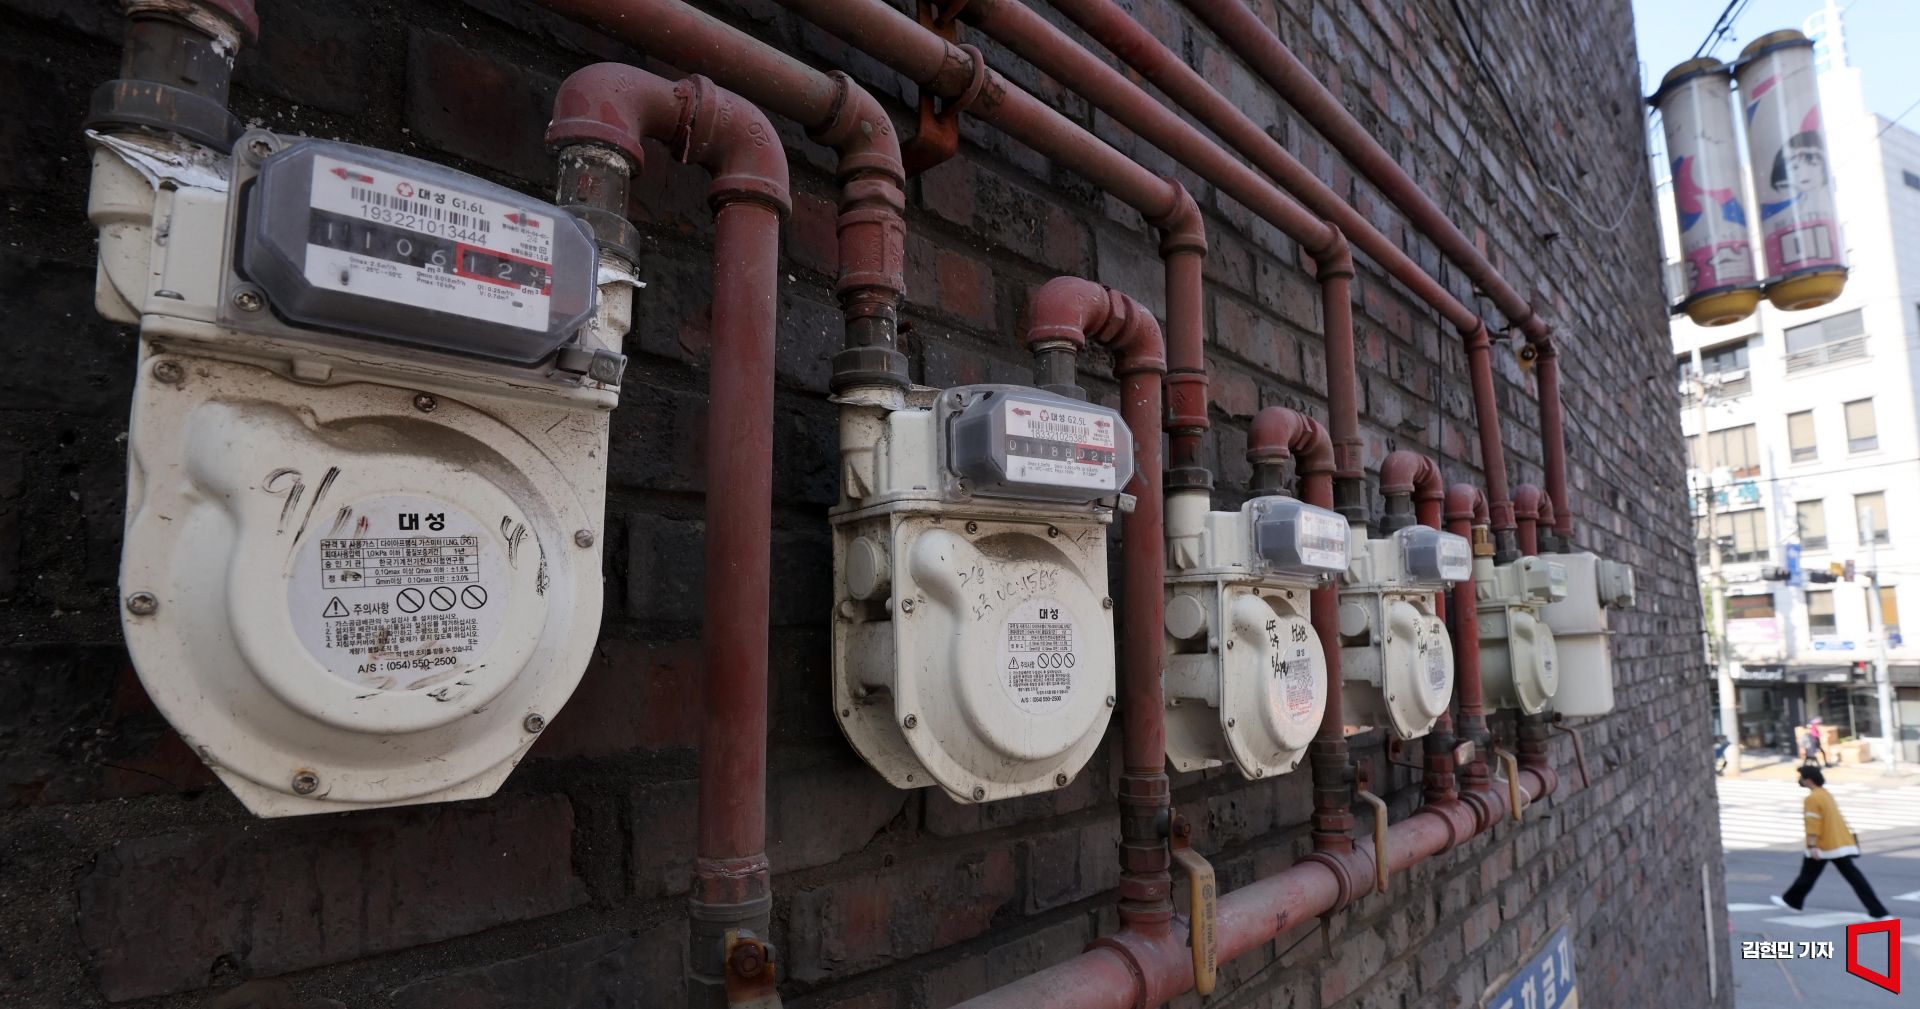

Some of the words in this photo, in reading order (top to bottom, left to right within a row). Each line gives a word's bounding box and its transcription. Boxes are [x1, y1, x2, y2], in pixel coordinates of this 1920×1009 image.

[419, 188, 445, 205] 대성
[452, 197, 485, 215] G1.6L
[361, 204, 487, 246] 193221013444
[1067, 415, 1086, 426] G2.5L
[398, 512, 445, 531] 대성
[353, 602, 390, 615] 주의사항
[1039, 608, 1059, 620] 대성
[357, 663, 377, 674] A/S
[386, 660, 411, 672] (054)
[412, 656, 457, 669] 550-2500
[1500, 935, 1571, 1009] 차금지
